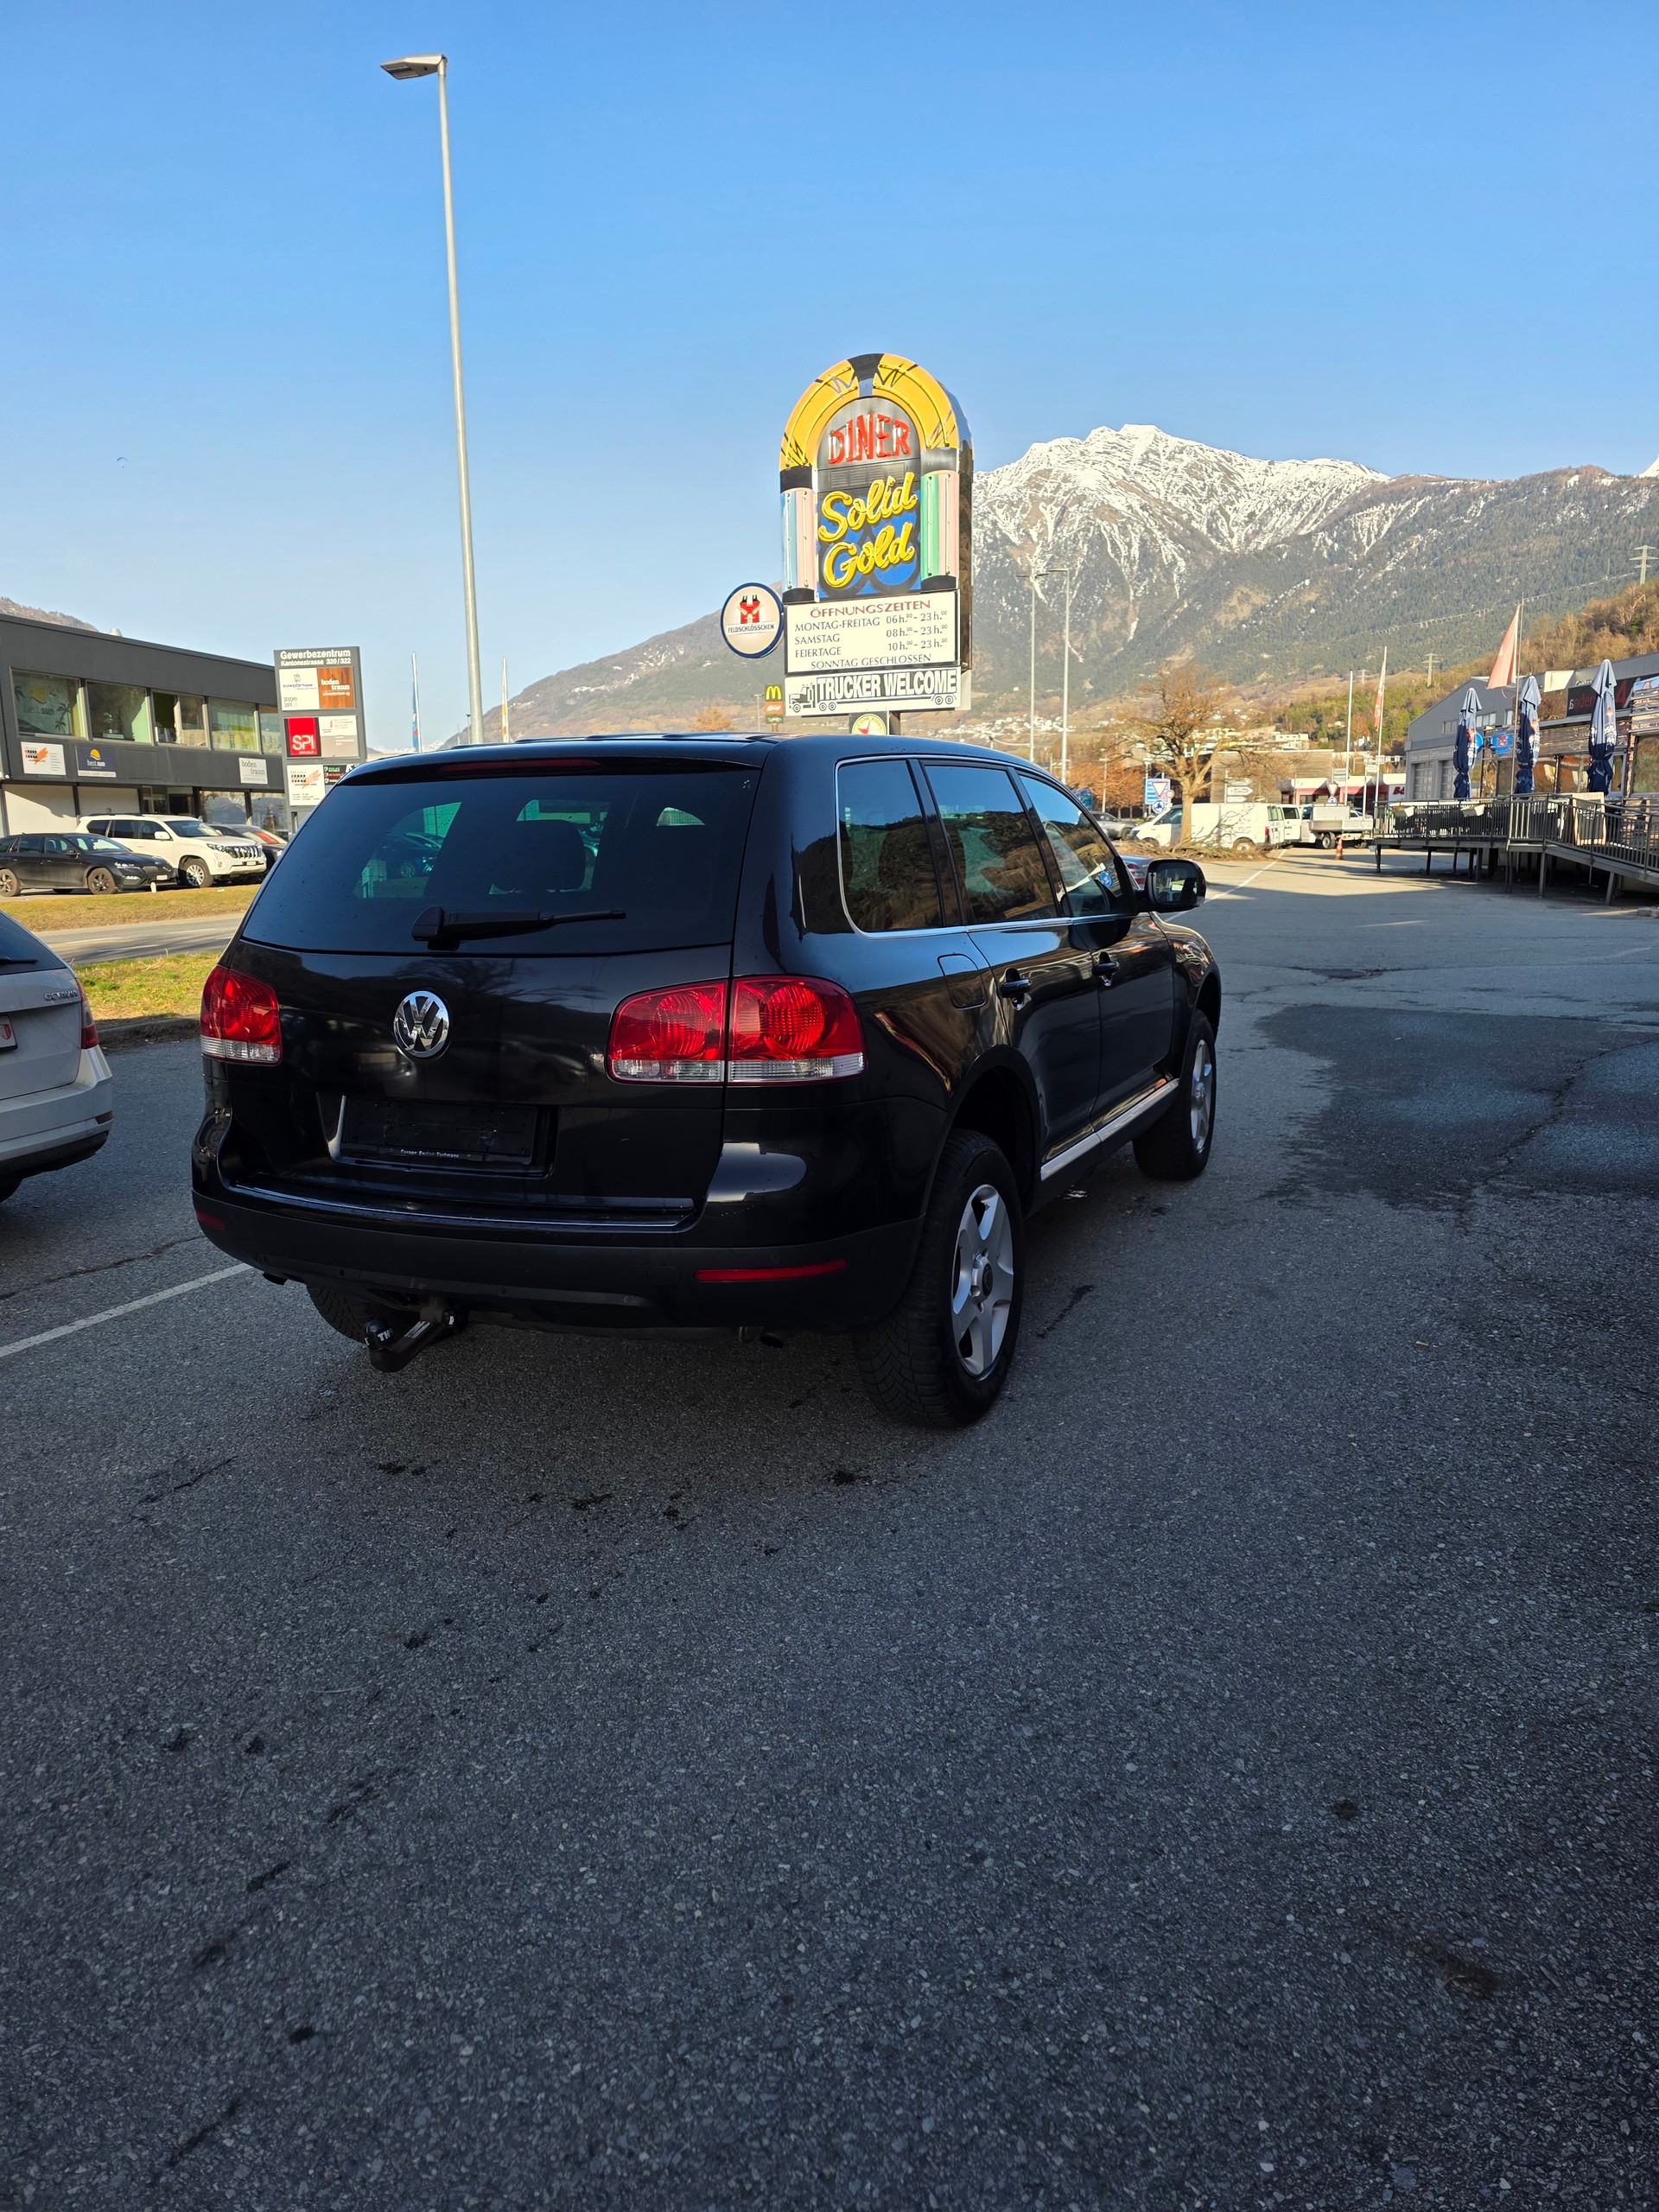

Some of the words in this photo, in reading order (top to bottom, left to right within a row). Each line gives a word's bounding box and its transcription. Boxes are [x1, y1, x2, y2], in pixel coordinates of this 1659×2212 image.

[828, 412, 911, 465] DINER
[818, 471, 918, 542] Solid
[823, 522, 915, 588] Gold
[810, 600, 931, 618] ÖFFNUNGSZEITEN
[728, 623, 775, 633] FELDSCHLÖSSCHEN
[795, 618, 880, 632] MONTAG-FREITAG
[795, 633, 840, 645] SAMSTAG
[280, 649, 351, 660] Gewerbezentrum
[795, 647, 842, 658] FEIERTAGE
[810, 658, 858, 670] SONNTAG
[861, 653, 931, 666] GESCHLOSSEN
[817, 673, 881, 701] TRUCKER
[883, 669, 957, 696] WELCOME
[41, 707, 54, 715] sun
[292, 734, 315, 751] SPI
[44, 989, 78, 1001] OCTAVIA
